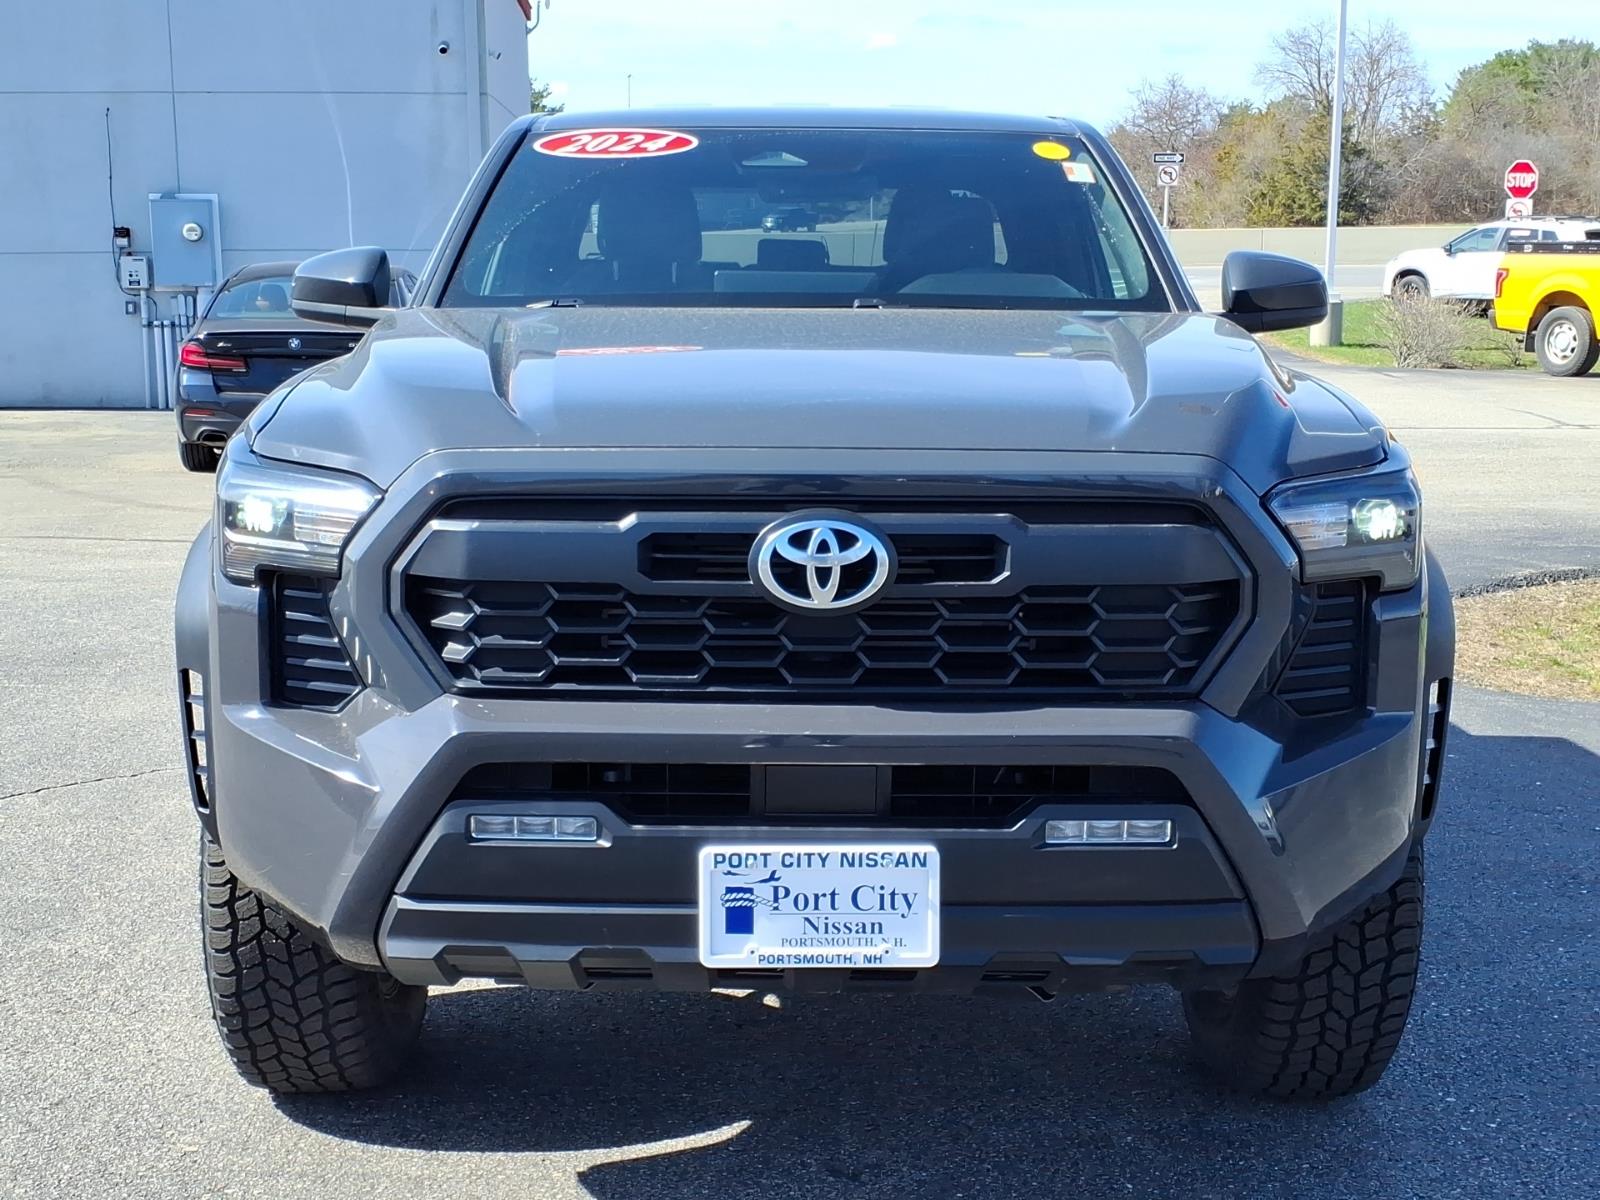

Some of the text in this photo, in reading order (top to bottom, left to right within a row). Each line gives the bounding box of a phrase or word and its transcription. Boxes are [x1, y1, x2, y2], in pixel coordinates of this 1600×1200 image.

[555, 134, 678, 152] 2024
[1507, 172, 1536, 188] STOP
[713, 852, 928, 869] PORT CITY NISSAN
[770, 884, 918, 919] Port City
[802, 916, 884, 935] Nissan
[781, 937, 877, 948] PORTSMOUTH,
[758, 954, 883, 965] PORTSMOUTH, NH
